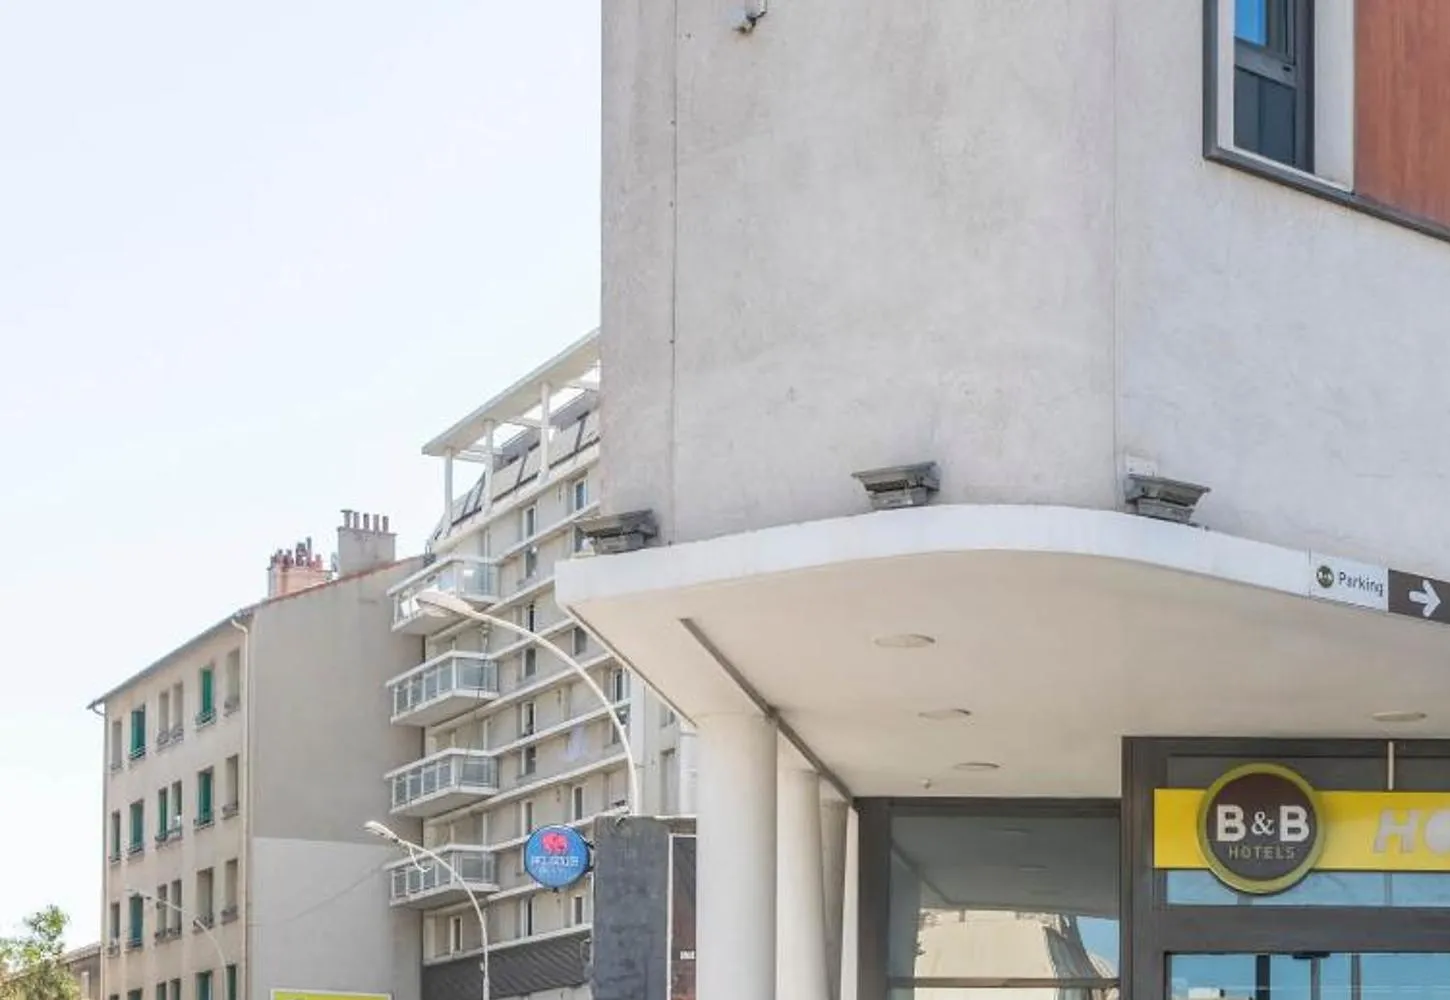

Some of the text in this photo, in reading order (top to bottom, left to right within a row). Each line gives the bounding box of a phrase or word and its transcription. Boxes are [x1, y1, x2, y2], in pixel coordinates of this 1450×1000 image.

[1338, 571, 1384, 597] Parking
[1216, 804, 1310, 842] B&B
[1228, 844, 1296, 861] HOTELS
